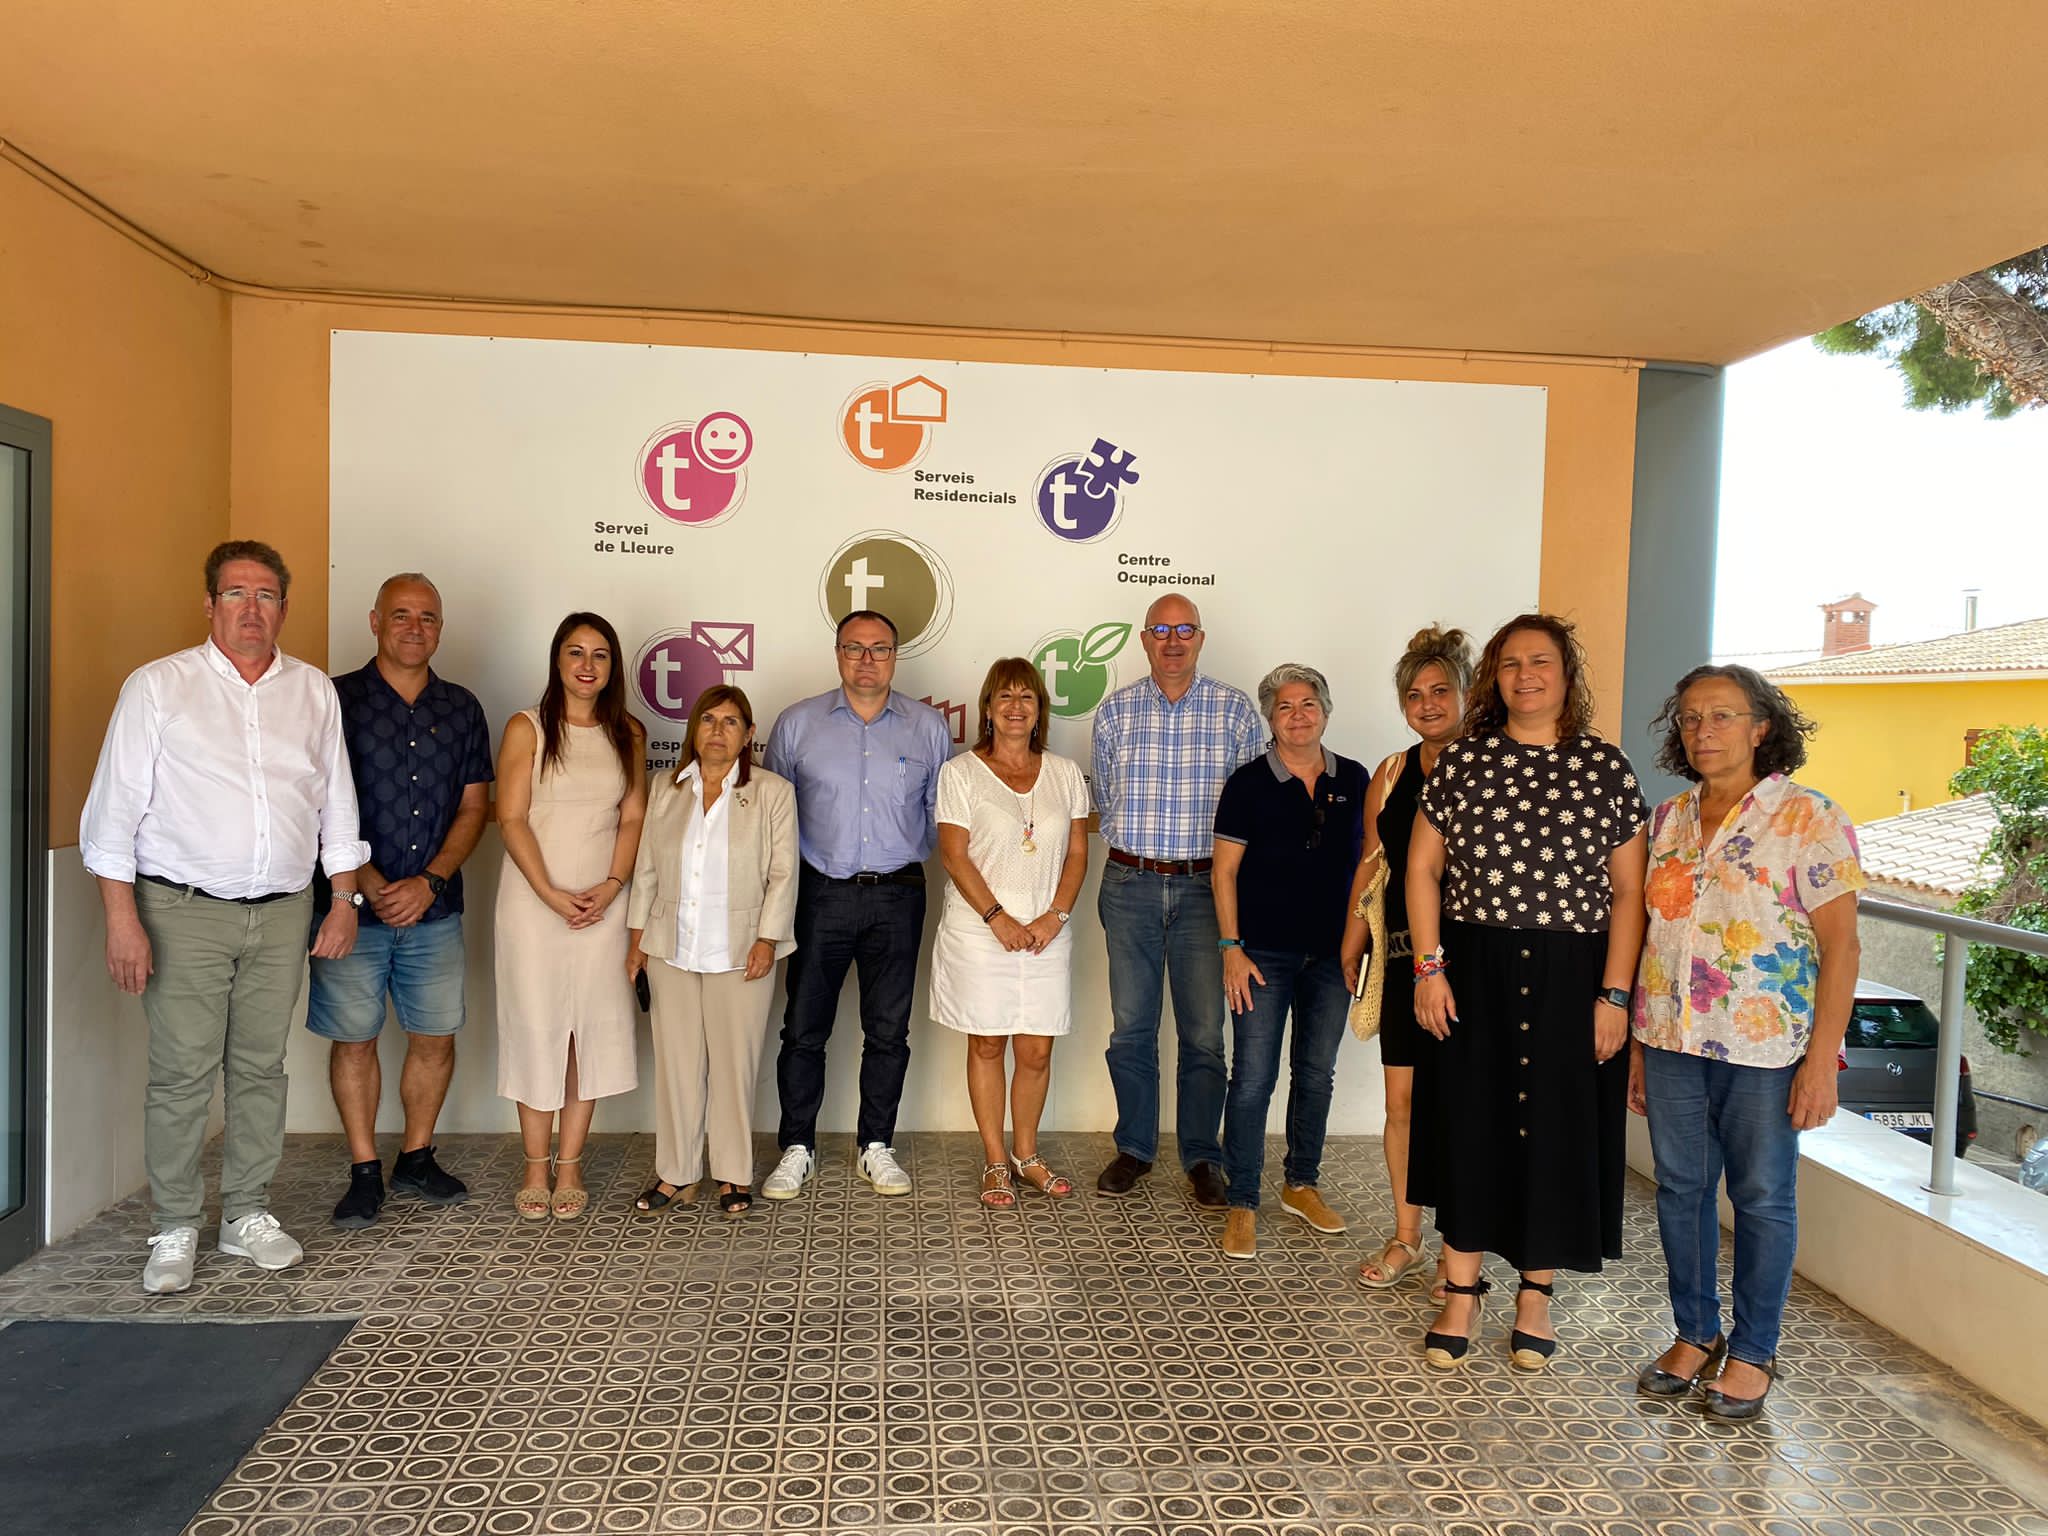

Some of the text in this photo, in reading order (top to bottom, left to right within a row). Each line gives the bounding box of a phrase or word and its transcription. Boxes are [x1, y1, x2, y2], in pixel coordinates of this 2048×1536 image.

[914, 470, 975, 484] Serveis
[914, 488, 1017, 504] Residencials
[594, 521, 649, 536] Servei
[594, 540, 674, 555] de Lleure
[1118, 553, 1171, 567] Centre
[1117, 571, 1215, 587] Ocupacional
[1909, 1114, 1931, 1127] JKL
